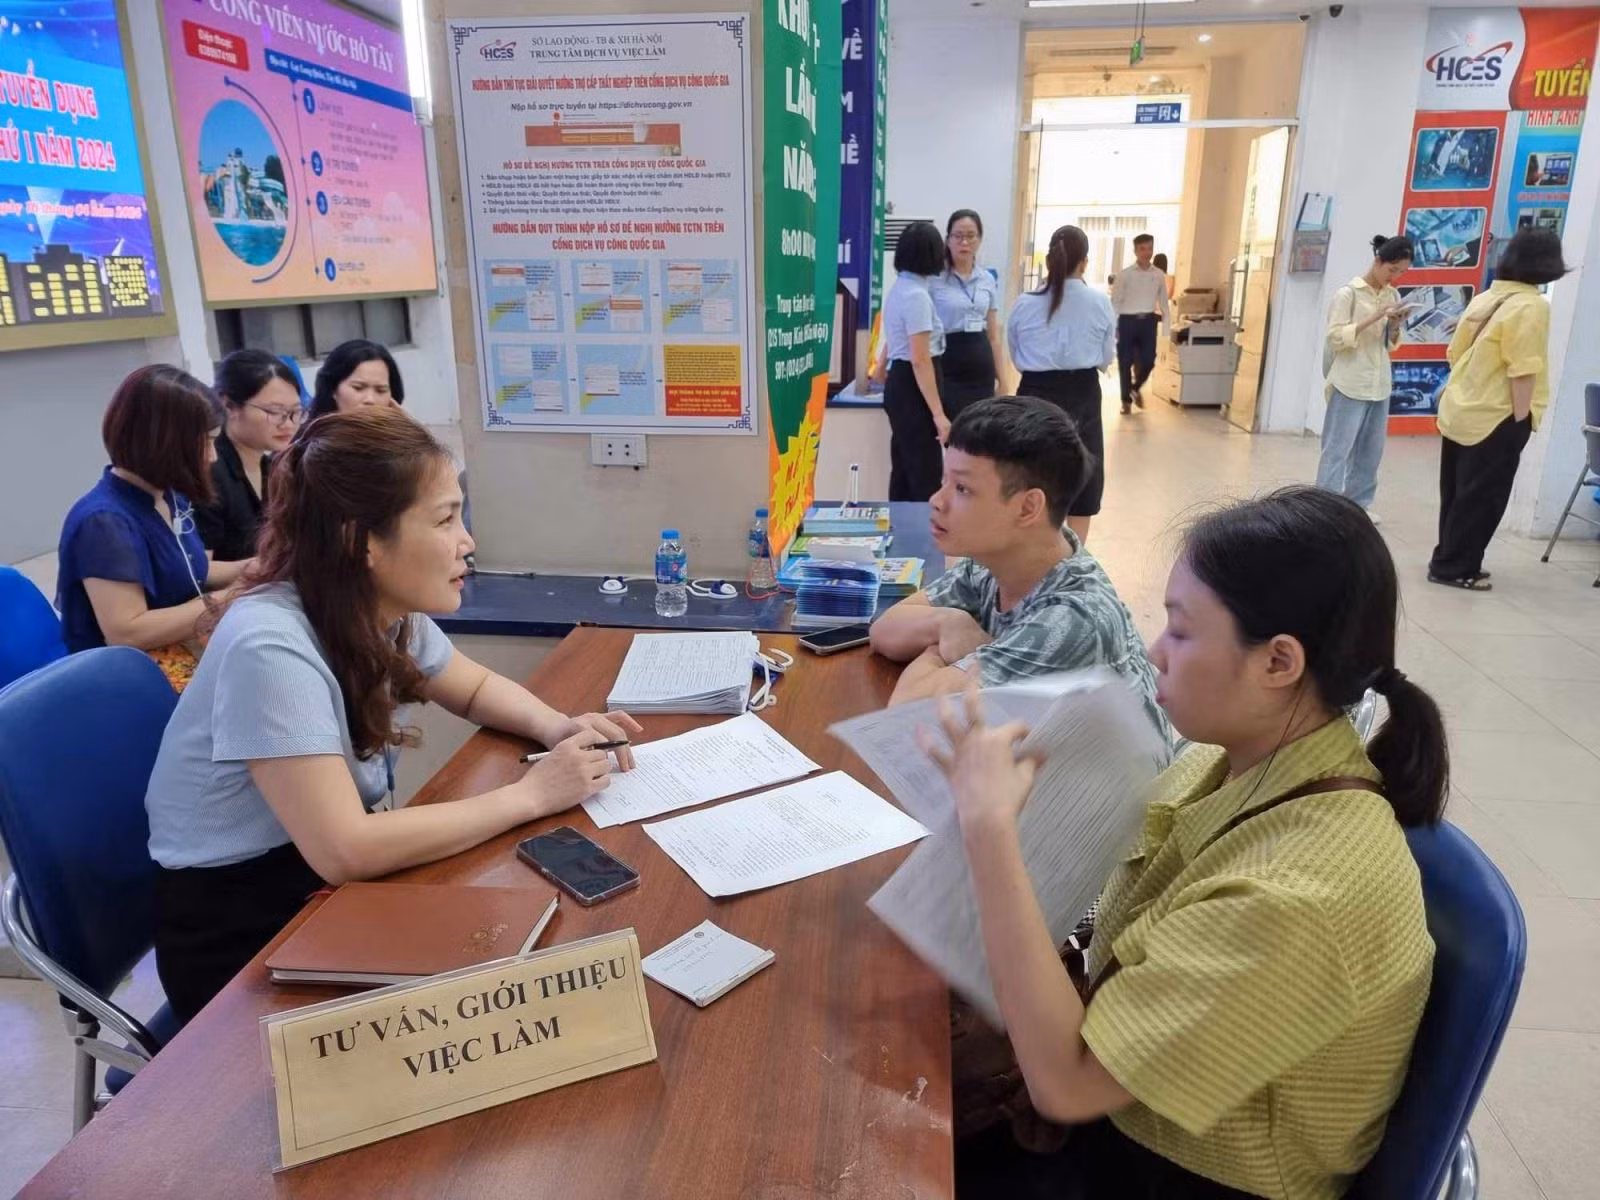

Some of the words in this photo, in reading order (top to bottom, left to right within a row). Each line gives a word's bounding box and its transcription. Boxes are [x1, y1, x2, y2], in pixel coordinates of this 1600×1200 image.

[544, 37, 563, 45] LAO
[564, 35, 589, 47] ĐỘNG
[596, 36, 606, 44] TB
[618, 35, 630, 44] XH
[647, 33, 663, 44] NỘI
[485, 48, 514, 58] HCES
[530, 49, 561, 59] TRUNG
[563, 47, 583, 58] TÂM
[584, 49, 606, 59] DỊCH
[607, 48, 620, 59] VỤ
[622, 47, 643, 58] VIỆC
[646, 45, 666, 56] LÀM
[1436, 56, 1503, 81] HCES
[53, 80, 98, 125] DỤNG
[76, 136, 117, 171] 2024
[492, 221, 518, 234] HƯỚNG
[520, 220, 536, 234] DẪN
[538, 224, 552, 234] QUY
[555, 221, 578, 234] TRÌNH
[580, 220, 595, 235] NỘP
[622, 219, 634, 233] ĐỀ
[634, 223, 652, 236] NGHỊ
[654, 220, 682, 233] HƯỞNG
[682, 223, 702, 232] TCTN
[704, 220, 724, 233] TRÊN
[552, 236, 574, 250] CỔNG
[574, 240, 594, 252] DỊCH
[594, 240, 606, 252] VỤ
[606, 238, 628, 250] CÔNG
[629, 236, 650, 251] QUỐC
[652, 240, 666, 250] GIA
[310, 1021, 362, 1059] TƯ
[368, 1003, 449, 1044] VẤN,
[456, 979, 527, 1019] GIỚI
[534, 956, 628, 999] THIỆU
[402, 1036, 483, 1079] VIỆC
[492, 1015, 562, 1057] LÀM
